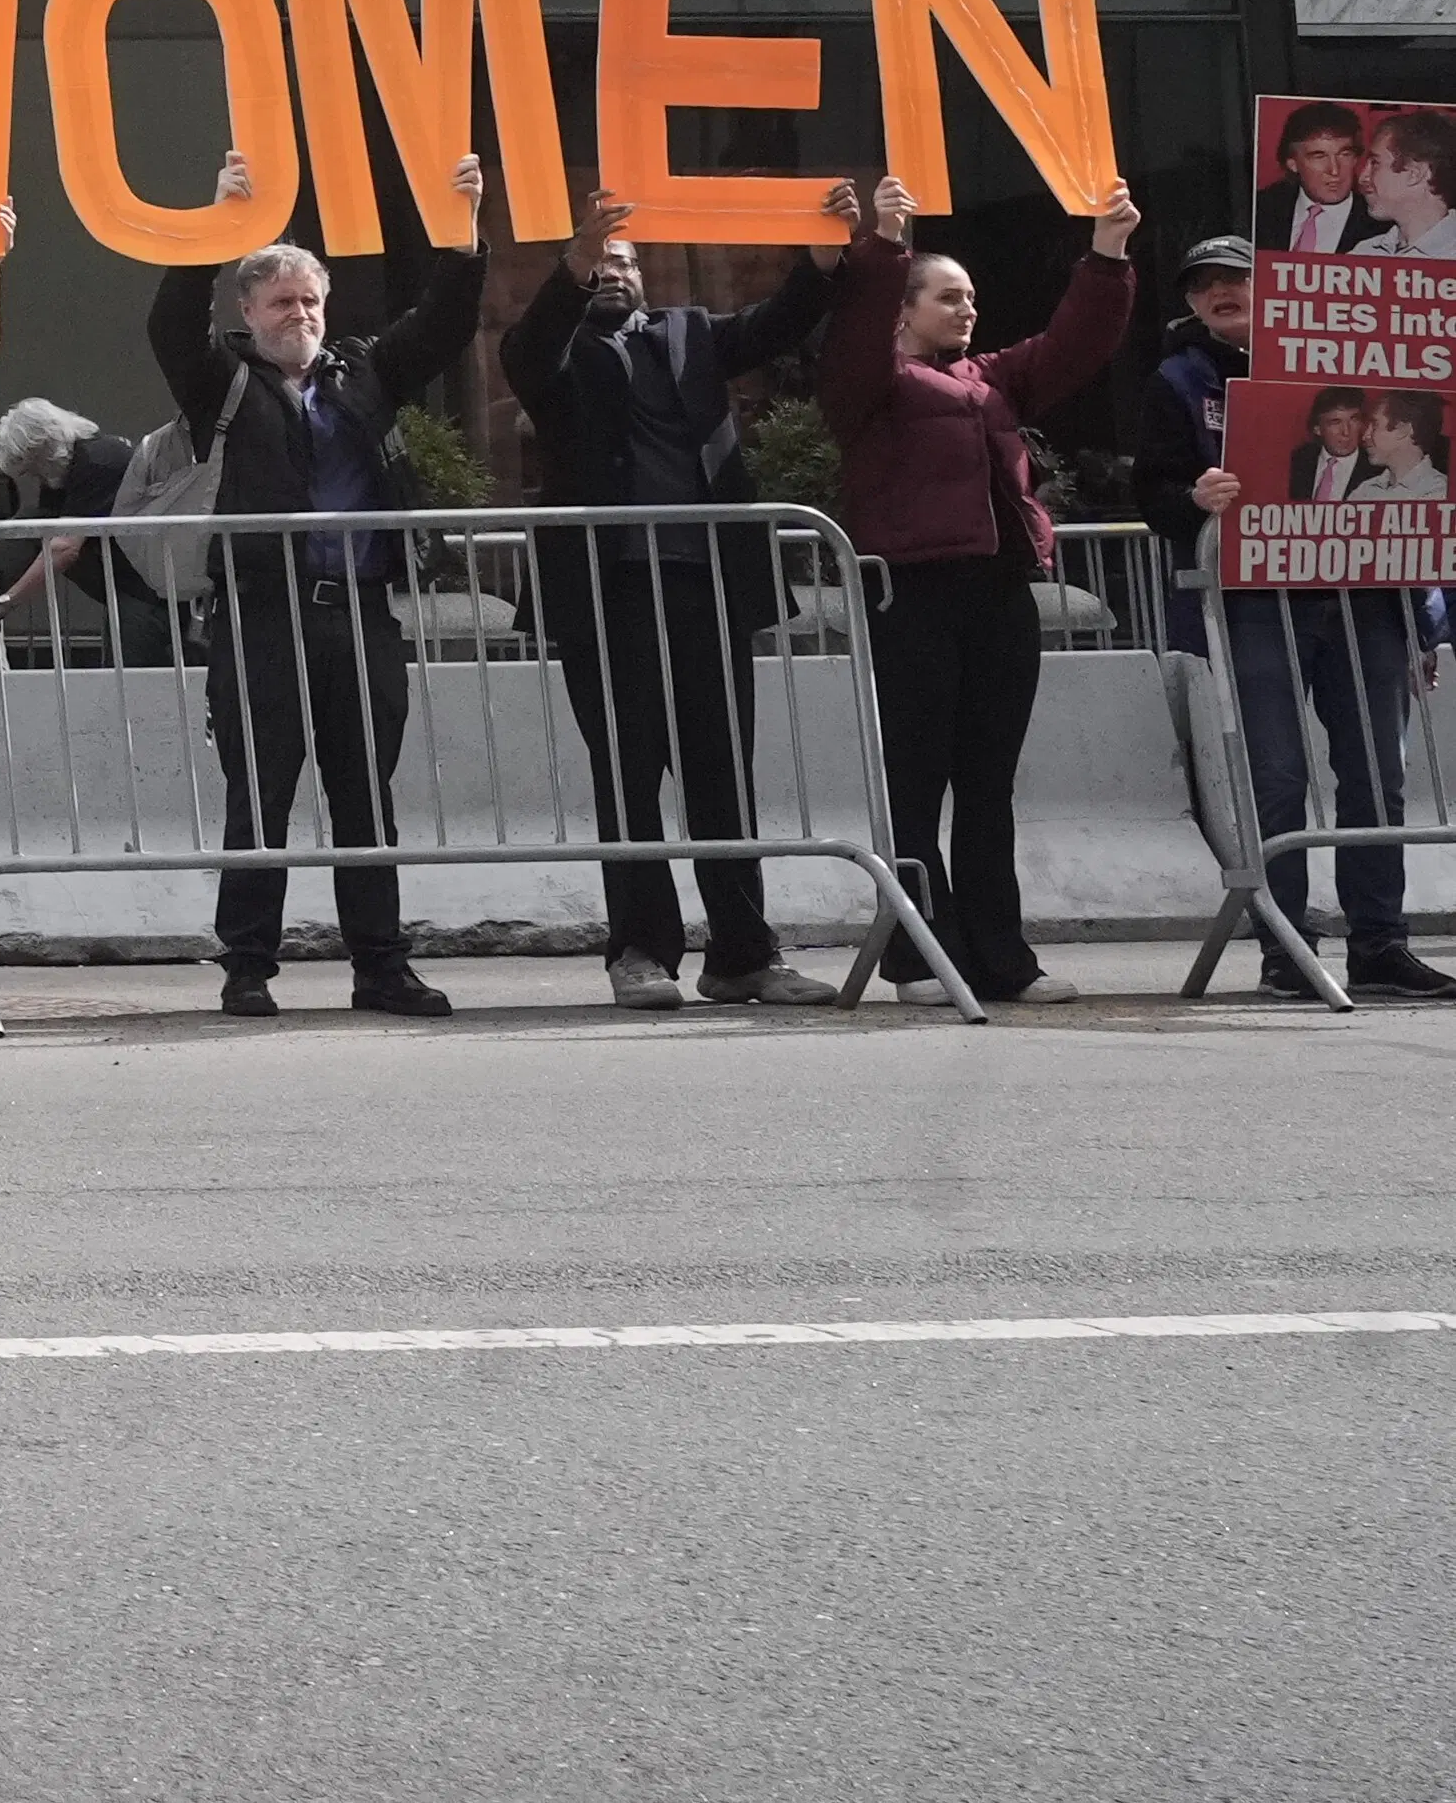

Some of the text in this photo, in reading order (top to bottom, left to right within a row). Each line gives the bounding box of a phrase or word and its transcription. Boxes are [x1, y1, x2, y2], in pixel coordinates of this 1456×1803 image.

[1271, 261, 1456, 301] TURN the
[1263, 298, 1378, 335] FILES
[1278, 337, 1453, 381] TRIALS
[1239, 503, 1376, 538] CONVICT
[1380, 504, 1430, 536] ALL
